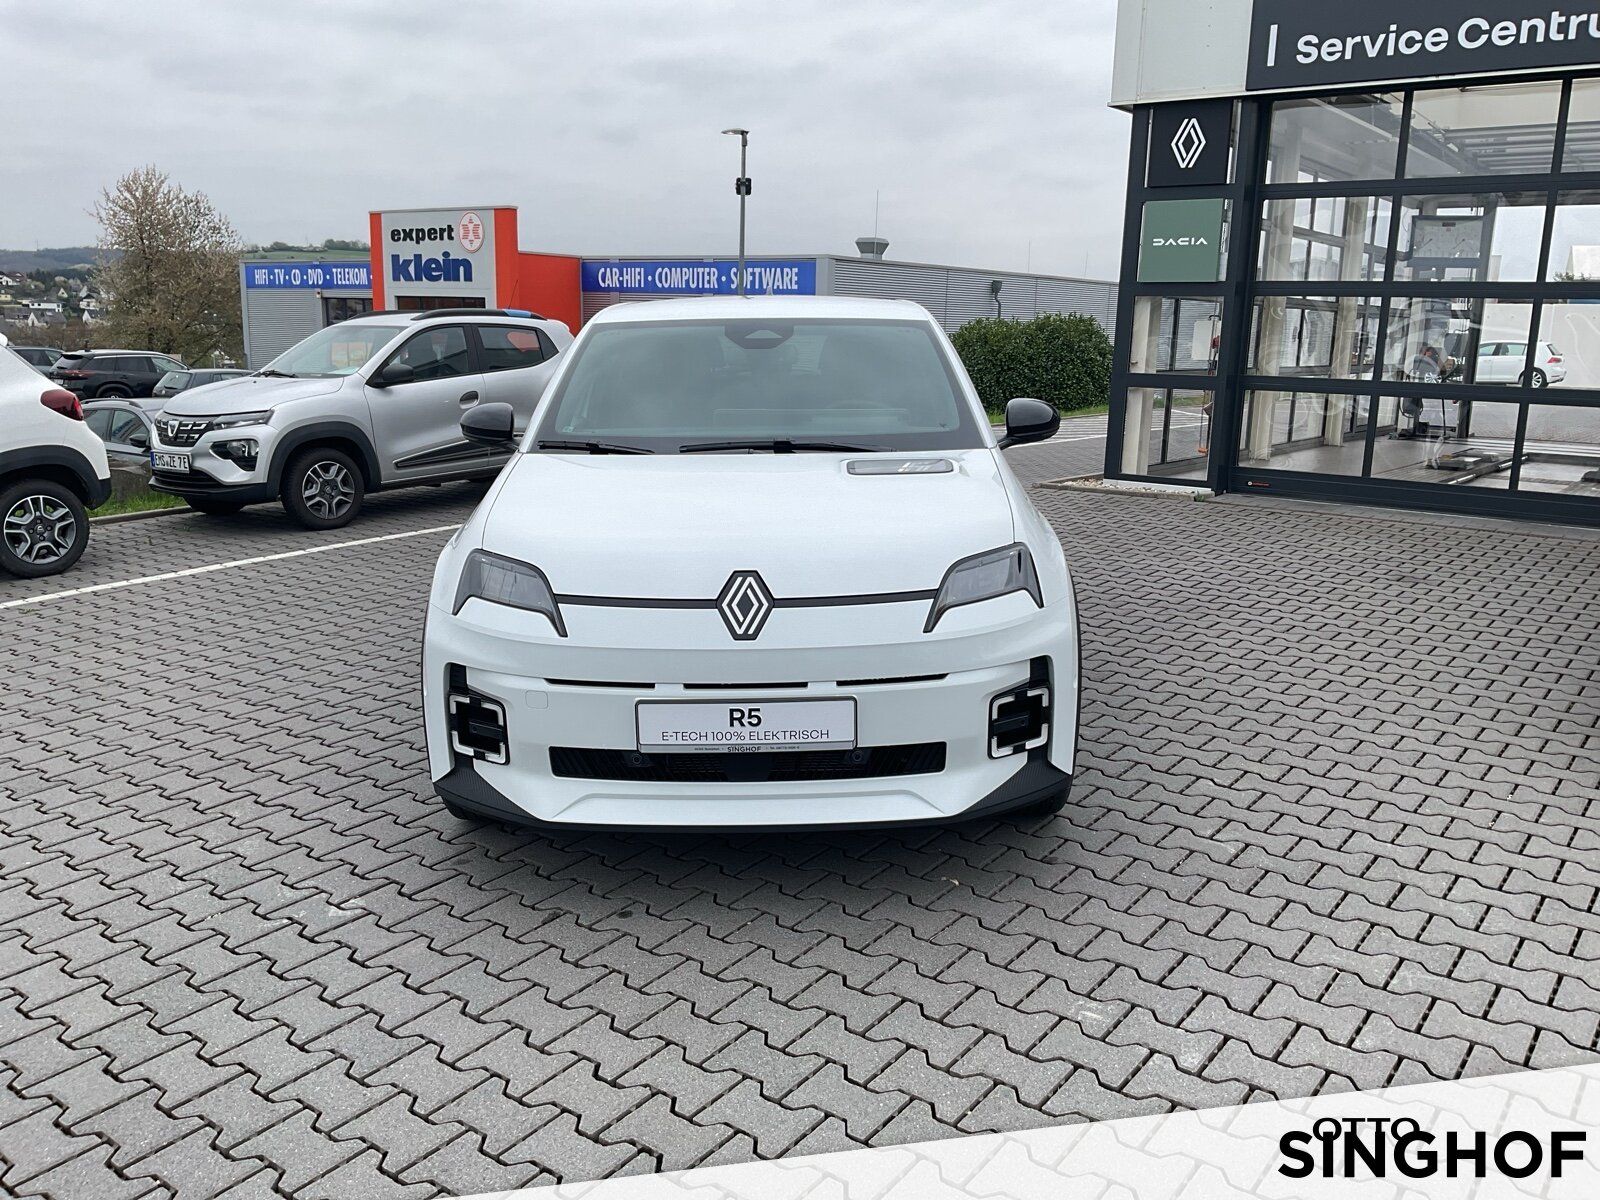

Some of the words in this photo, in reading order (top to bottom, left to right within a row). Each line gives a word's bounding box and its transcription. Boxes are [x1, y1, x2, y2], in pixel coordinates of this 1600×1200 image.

[1296, 24, 1449, 64] Service
[390, 224, 455, 244] expert
[1152, 237, 1208, 246] DACIA
[391, 250, 473, 282] klein
[254, 269, 269, 285] HIFI
[274, 269, 285, 284] TV
[291, 268, 301, 285] CD
[307, 268, 324, 285] DVD
[332, 268, 368, 285] TELEKOM
[598, 267, 645, 288] CAR-HIFI
[655, 267, 718, 289] COMPUTER
[728, 708, 762, 728] R5
[661, 730, 708, 742] E-TECH
[711, 731, 746, 741] 100%
[749, 729, 830, 742] ELEKTRISCH
